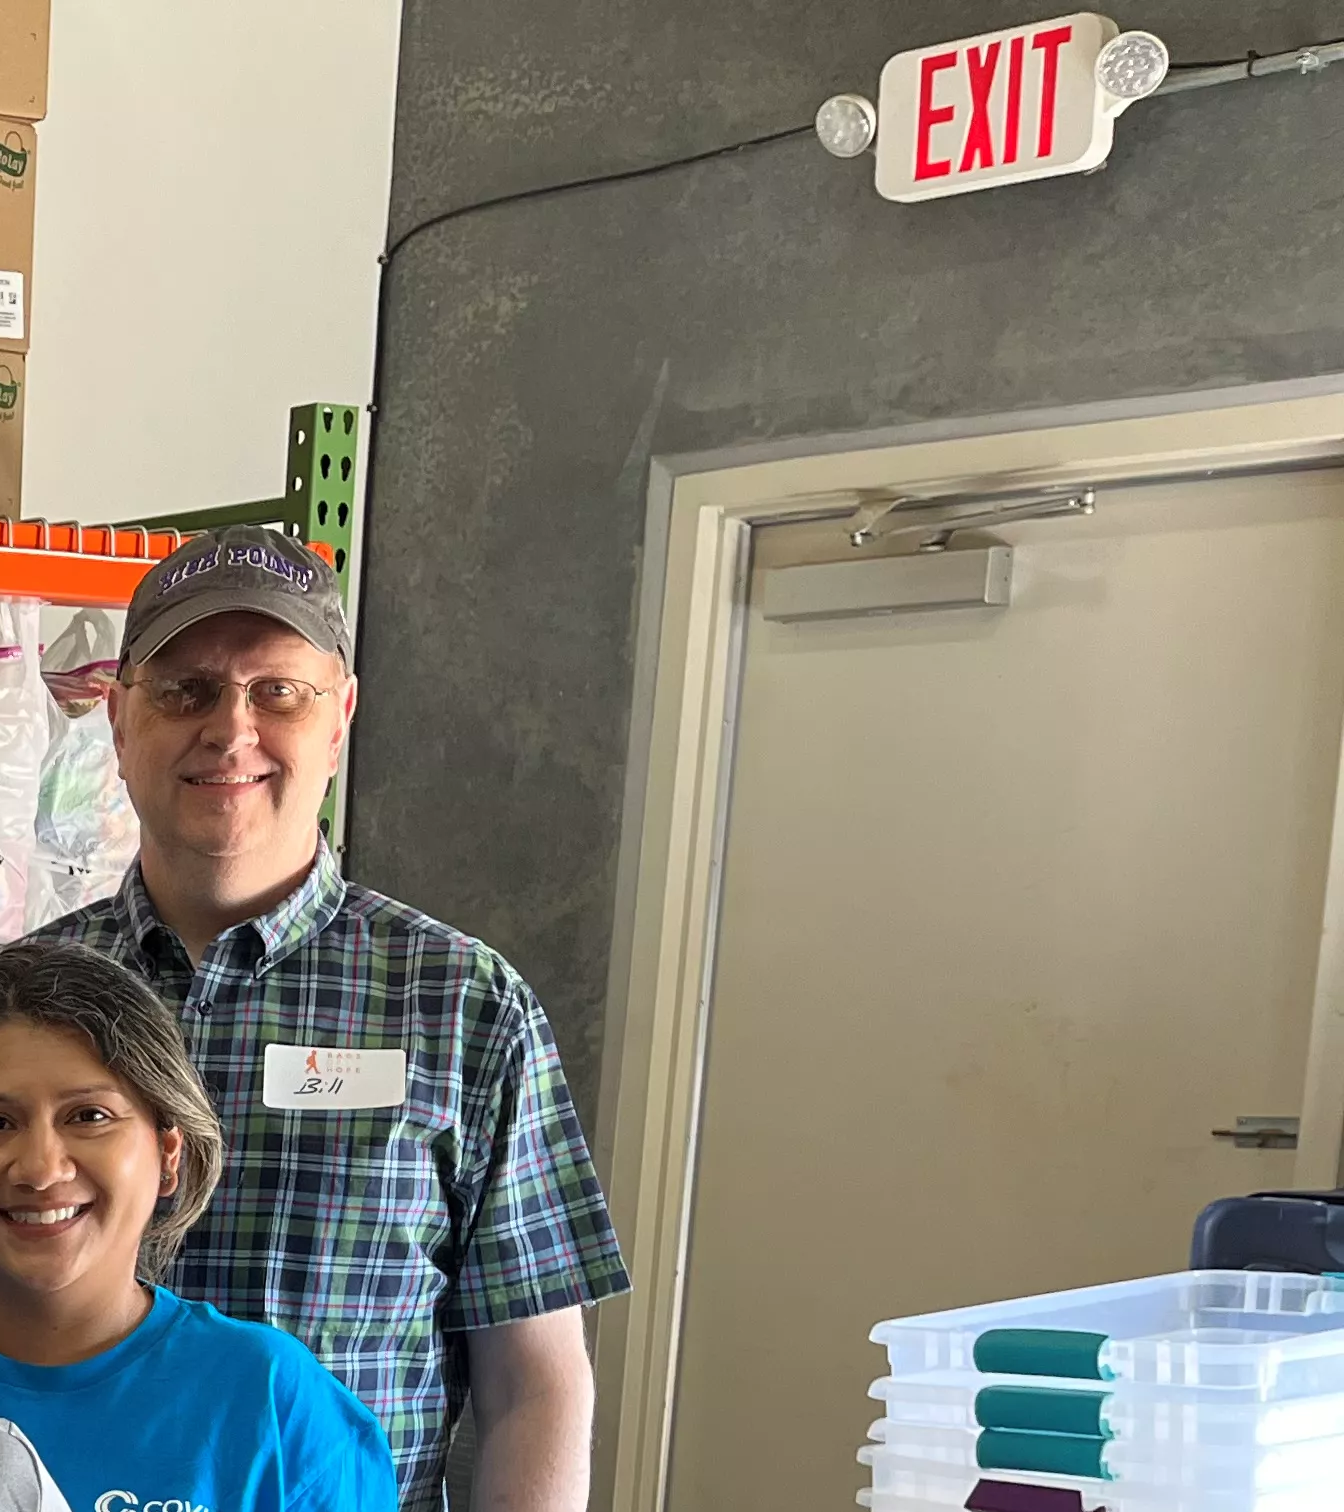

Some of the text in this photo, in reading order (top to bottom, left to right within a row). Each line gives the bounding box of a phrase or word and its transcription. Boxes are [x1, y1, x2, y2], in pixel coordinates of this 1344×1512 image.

[914, 26, 1072, 182] EXIT
[227, 546, 313, 592] POINT
[293, 1077, 344, 1095] Bill
